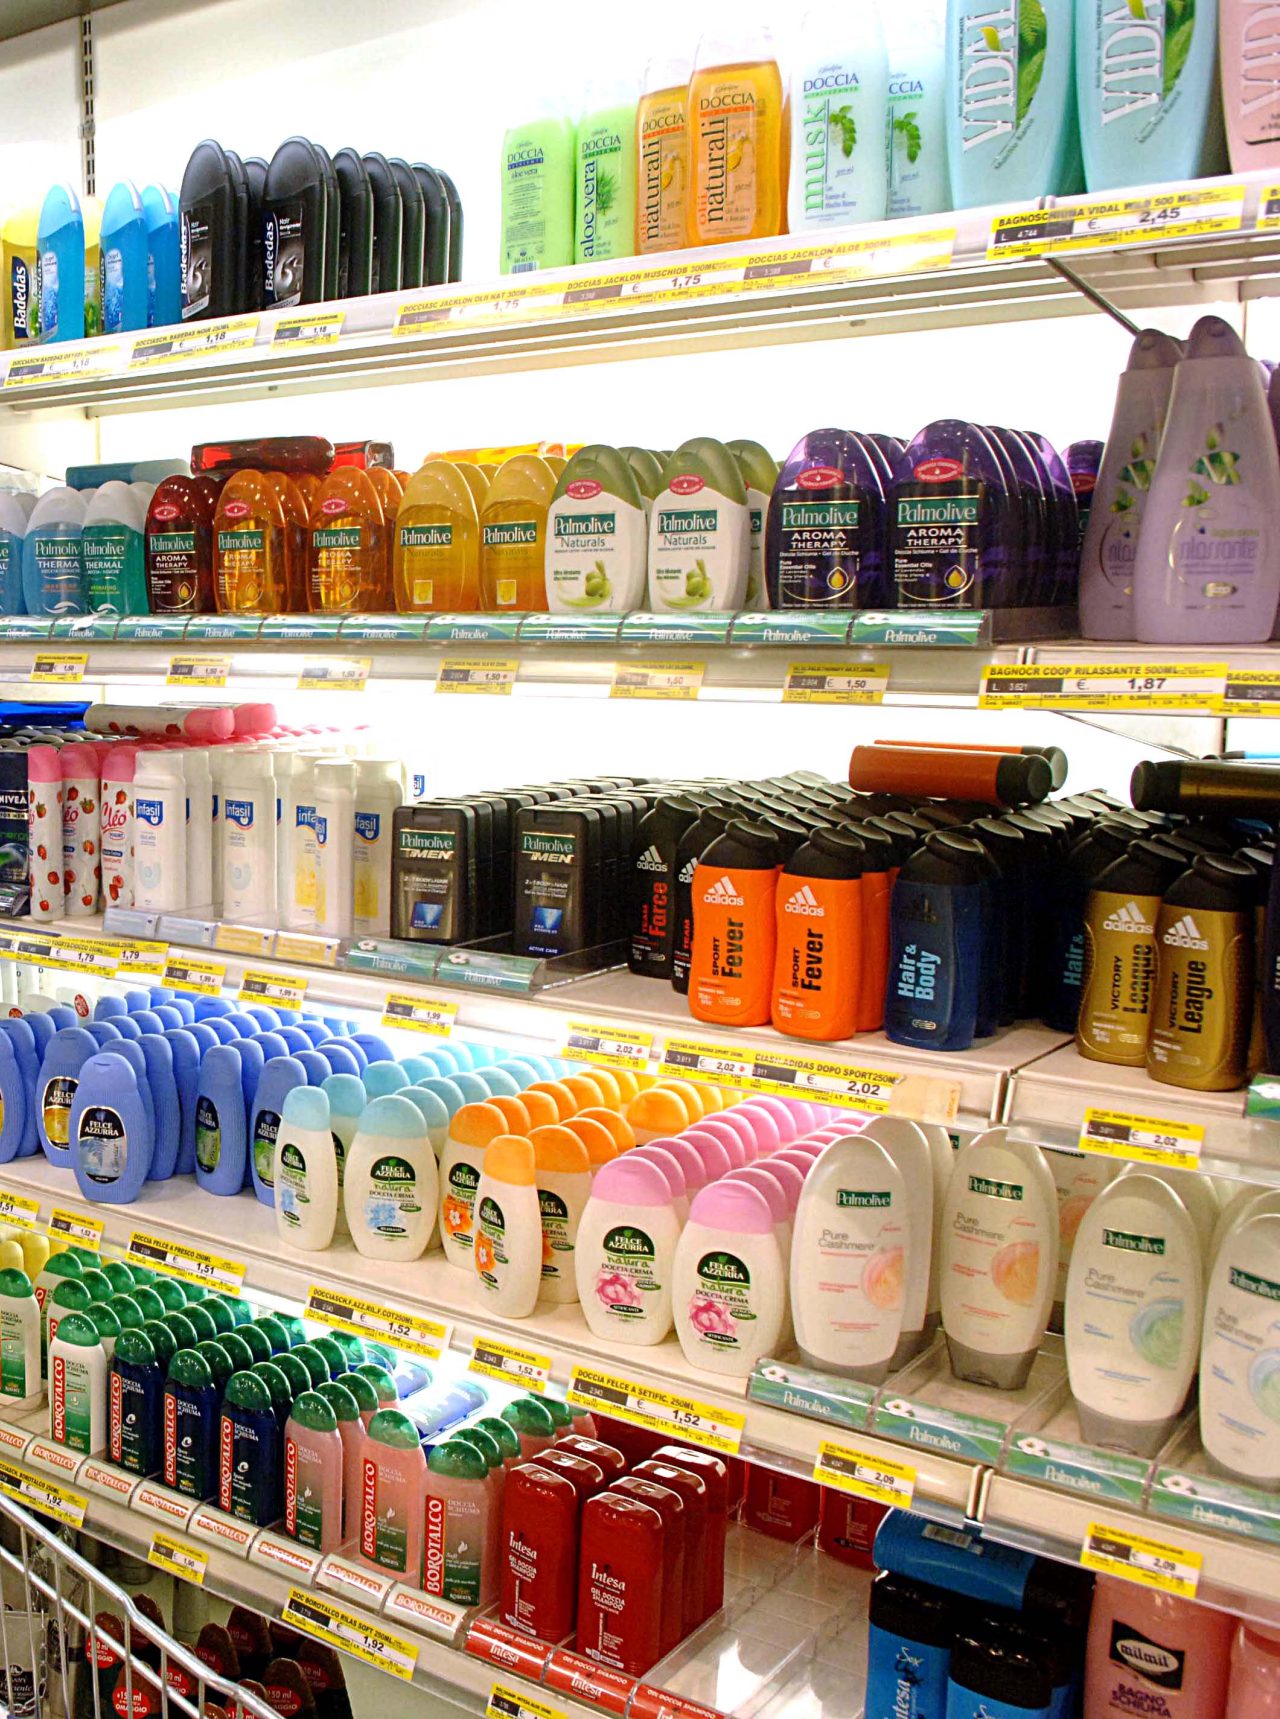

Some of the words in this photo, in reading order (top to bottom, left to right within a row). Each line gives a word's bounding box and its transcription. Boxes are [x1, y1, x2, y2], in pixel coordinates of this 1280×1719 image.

[803, 73, 860, 92] DOCCIA
[963, 8, 1018, 152] VIDAL
[700, 92, 755, 111] DOCCIA
[581, 134, 621, 153] DOCCIA
[507, 147, 544, 163] DOCCIA
[802, 104, 827, 213] musk
[701, 117, 727, 223] naturali
[584, 160, 596, 209] vera
[643, 139, 661, 242] naturali
[1087, 202, 1119, 214] VIDAL
[1138, 207, 1180, 223] 2,45
[581, 215, 595, 258] aloe
[265, 221, 274, 292] Badedas
[748, 253, 788, 265] DOCCIAS
[836, 243, 860, 255] ALOE
[567, 278, 602, 289] DOCCIAS
[670, 274, 701, 288] 1,75
[14, 265, 27, 330] Badedas
[493, 299, 520, 313] 1,75
[205, 331, 226, 344] 1,18
[783, 507, 857, 527] Palmolive
[898, 503, 976, 523] Palmolive
[554, 515, 614, 535] Palmolive
[658, 513, 716, 532] Palmolive
[400, 527, 451, 545] Palmolive
[483, 526, 536, 544] Palmolive
[664, 534, 708, 546] Naturals
[792, 531, 846, 541] AROMA
[907, 528, 965, 537] AROMA
[561, 536, 606, 549] Naturals
[791, 540, 846, 549] THERAPY
[907, 537, 964, 546] THERAPY
[86, 561, 123, 569] THERMAL
[155, 554, 188, 562] AROMA
[990, 666, 1040, 676] BAGNOCR
[1043, 666, 1072, 676] COOP
[1074, 666, 1142, 676] RILASSANTE
[1145, 665, 1179, 676] 500ML
[847, 680, 867, 690] 1,50
[1127, 677, 1167, 691] 1,87
[100, 801, 127, 828] Cléo
[136, 802, 162, 819] infasil
[226, 803, 252, 819] infasil
[402, 833, 452, 849] Palmolive
[523, 836, 573, 852] Palmolive
[410, 850, 454, 860] MEN
[530, 853, 574, 864] MEN
[637, 860, 669, 873] adidas
[703, 893, 744, 906] adidas
[649, 882, 669, 937] Force
[784, 903, 825, 917] adidas
[1104, 920, 1154, 935] adidas
[721, 918, 744, 979] Fever
[1164, 934, 1208, 951] adidas
[78, 952, 95, 963] 1,79
[121, 950, 140, 960] 1,79
[712, 937, 721, 977] SPORT
[801, 929, 824, 991] Fever
[792, 947, 801, 988] SPORT
[898, 953, 916, 998] Hair
[915, 951, 942, 1000] Body
[1064, 952, 1084, 986] Hair
[1110, 955, 1122, 1010] VICTORY
[1169, 972, 1179, 1027] VICTORY
[1179, 960, 1212, 1034] League
[426, 1011, 441, 1020] 1,99
[616, 1044, 633, 1054] 2,02
[817, 1062, 841, 1074] DOPO
[847, 1080, 880, 1097] 2,02
[84, 1127, 119, 1137] AZZURRA
[90, 1121, 113, 1129] FELCE
[1154, 1134, 1178, 1147] 2,02
[375, 1171, 412, 1180] AZZURRA
[381, 1165, 405, 1173] FELCE
[956, 1212, 980, 1227] Pure
[822, 1229, 850, 1241] Pure
[953, 1221, 1005, 1241] Cashmere
[174, 1244, 194, 1257] FRESCO
[608, 1242, 649, 1253] AZZURRA
[819, 1238, 875, 1251] Cashmere
[196, 1263, 214, 1276] 1,51
[607, 1255, 650, 1269] natura
[629, 1267, 654, 1276] CREMA
[1089, 1268, 1116, 1283] Pure
[701, 1282, 746, 1297] natura
[1085, 1277, 1144, 1299] Cashmere
[724, 1294, 749, 1305] CREMA
[388, 1322, 411, 1337] 1,52
[518, 1364, 533, 1376] 1,52
[578, 1369, 605, 1384] DOCCIA
[606, 1378, 630, 1391] FELCE
[638, 1388, 669, 1404] SETIFIC.
[670, 1397, 695, 1411] 250ML
[53, 1358, 65, 1442] BOROTALCO
[672, 1408, 700, 1426] 1,52
[165, 1396, 176, 1485] BOROTALCO
[221, 1417, 233, 1509] BOROTALCO
[875, 1472, 895, 1485] 2,09
[1045, 1466, 1101, 1493] Palmolive
[286, 1441, 297, 1533] BOROTALCO
[45, 1493, 62, 1507] 1,92
[425, 1498, 444, 1594] BOROTALCO
[509, 1531, 538, 1560] Intesa
[1153, 1558, 1176, 1572] 2,09
[591, 1563, 626, 1591] Intesa
[292, 1590, 304, 1600] DOC
[305, 1597, 340, 1619] BOROTALCO
[340, 1614, 357, 1627] RILAS
[358, 1621, 373, 1634] SOFT
[363, 1636, 384, 1652] 1,92
[1121, 1643, 1170, 1669] milmil
[571, 1672, 602, 1697] Intesa
[597, 1668, 628, 1685] SHAMPOO
[1118, 1684, 1166, 1705] BAGNO
[683, 1703, 716, 1719] SHAMPOO
[1111, 1690, 1172, 1719] SCHIUMA
